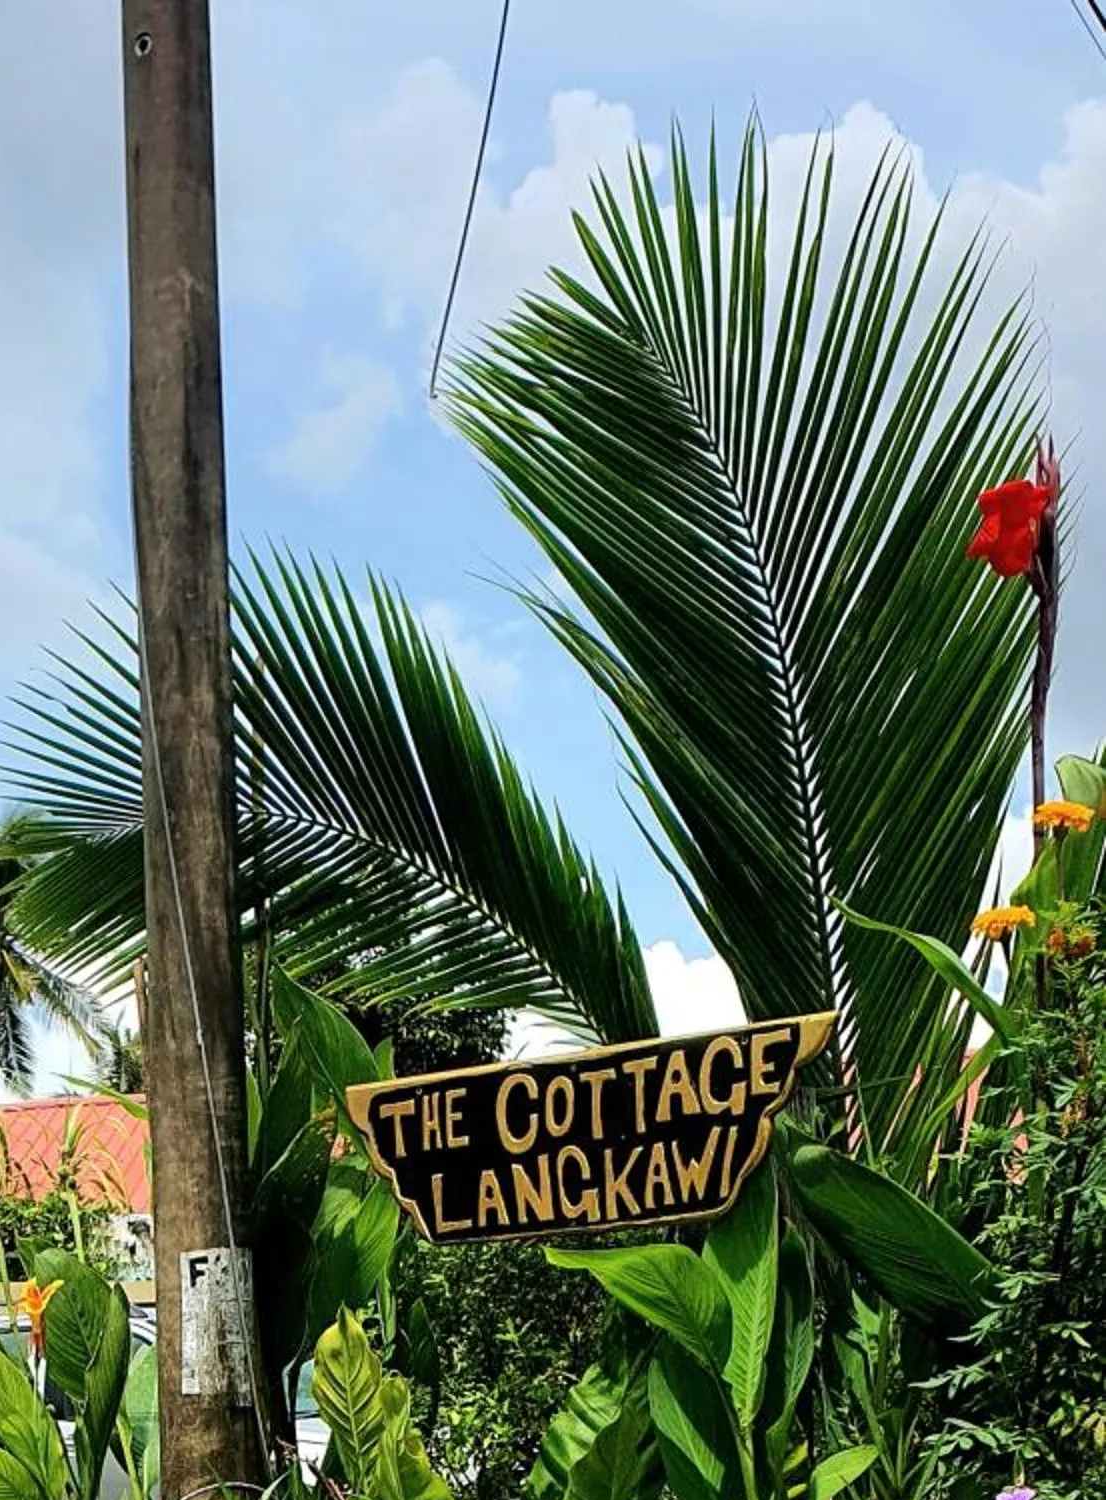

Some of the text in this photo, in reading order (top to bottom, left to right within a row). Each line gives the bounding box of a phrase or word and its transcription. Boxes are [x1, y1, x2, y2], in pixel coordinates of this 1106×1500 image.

[379, 1028, 792, 1158] THE COTTAGE
[431, 1126, 738, 1233] LANGKAWI
